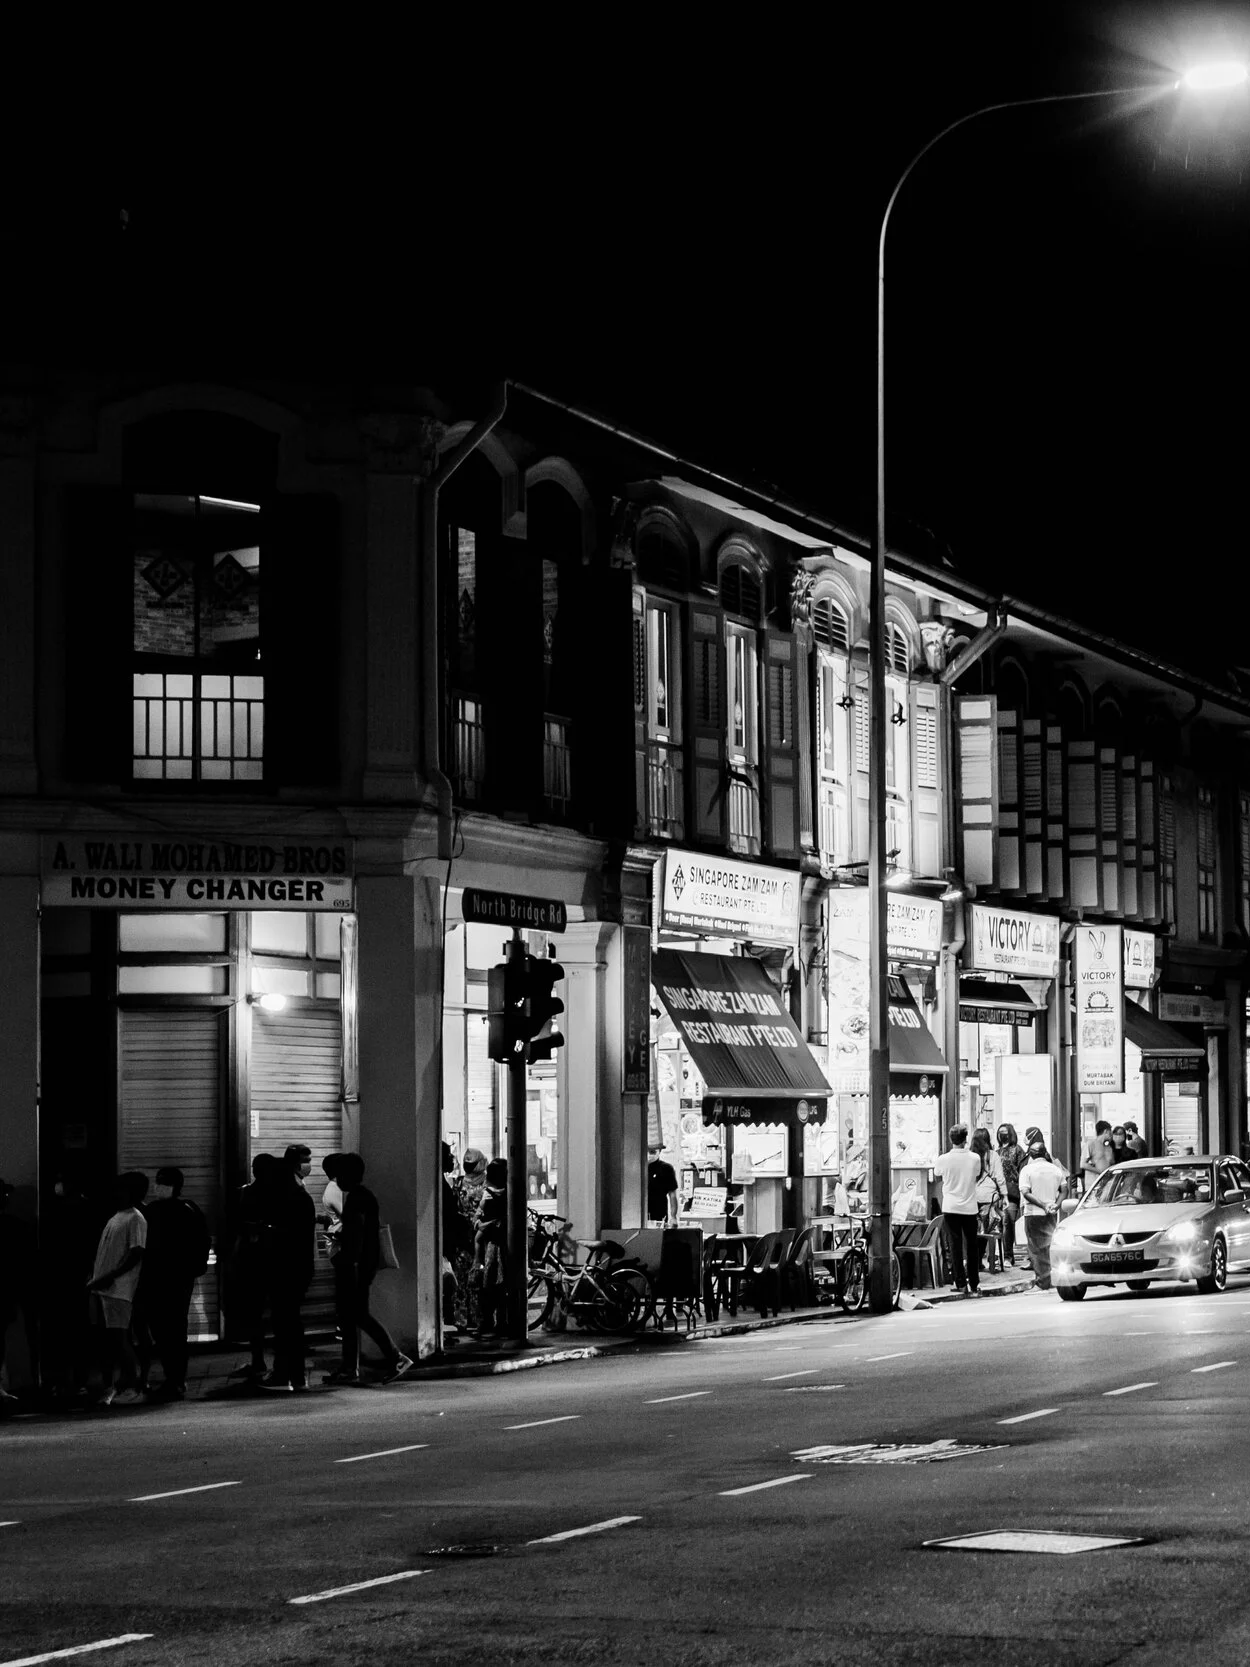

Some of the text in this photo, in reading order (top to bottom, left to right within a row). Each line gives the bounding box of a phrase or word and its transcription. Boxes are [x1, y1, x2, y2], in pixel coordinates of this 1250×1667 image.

[52, 842, 346, 874] A. WALI MOHAMED BROS
[71, 877, 325, 901] MONEY CHANGER
[690, 866, 739, 890] SINGAPORE
[741, 875, 759, 893] ZAM
[760, 879, 778, 896] ZAM
[333, 899, 350, 908] 695
[473, 894, 562, 926] North Bridge Rd
[700, 893, 742, 909] RESTAURANT
[988, 916, 1031, 952] VICTORY
[1081, 971, 1116, 980] VICTORY
[662, 985, 781, 1016] SINGAPORE ZAM ZAM
[681, 1020, 798, 1048] RESTAURANT PTE LTD
[740, 1106, 751, 1118] Gas
